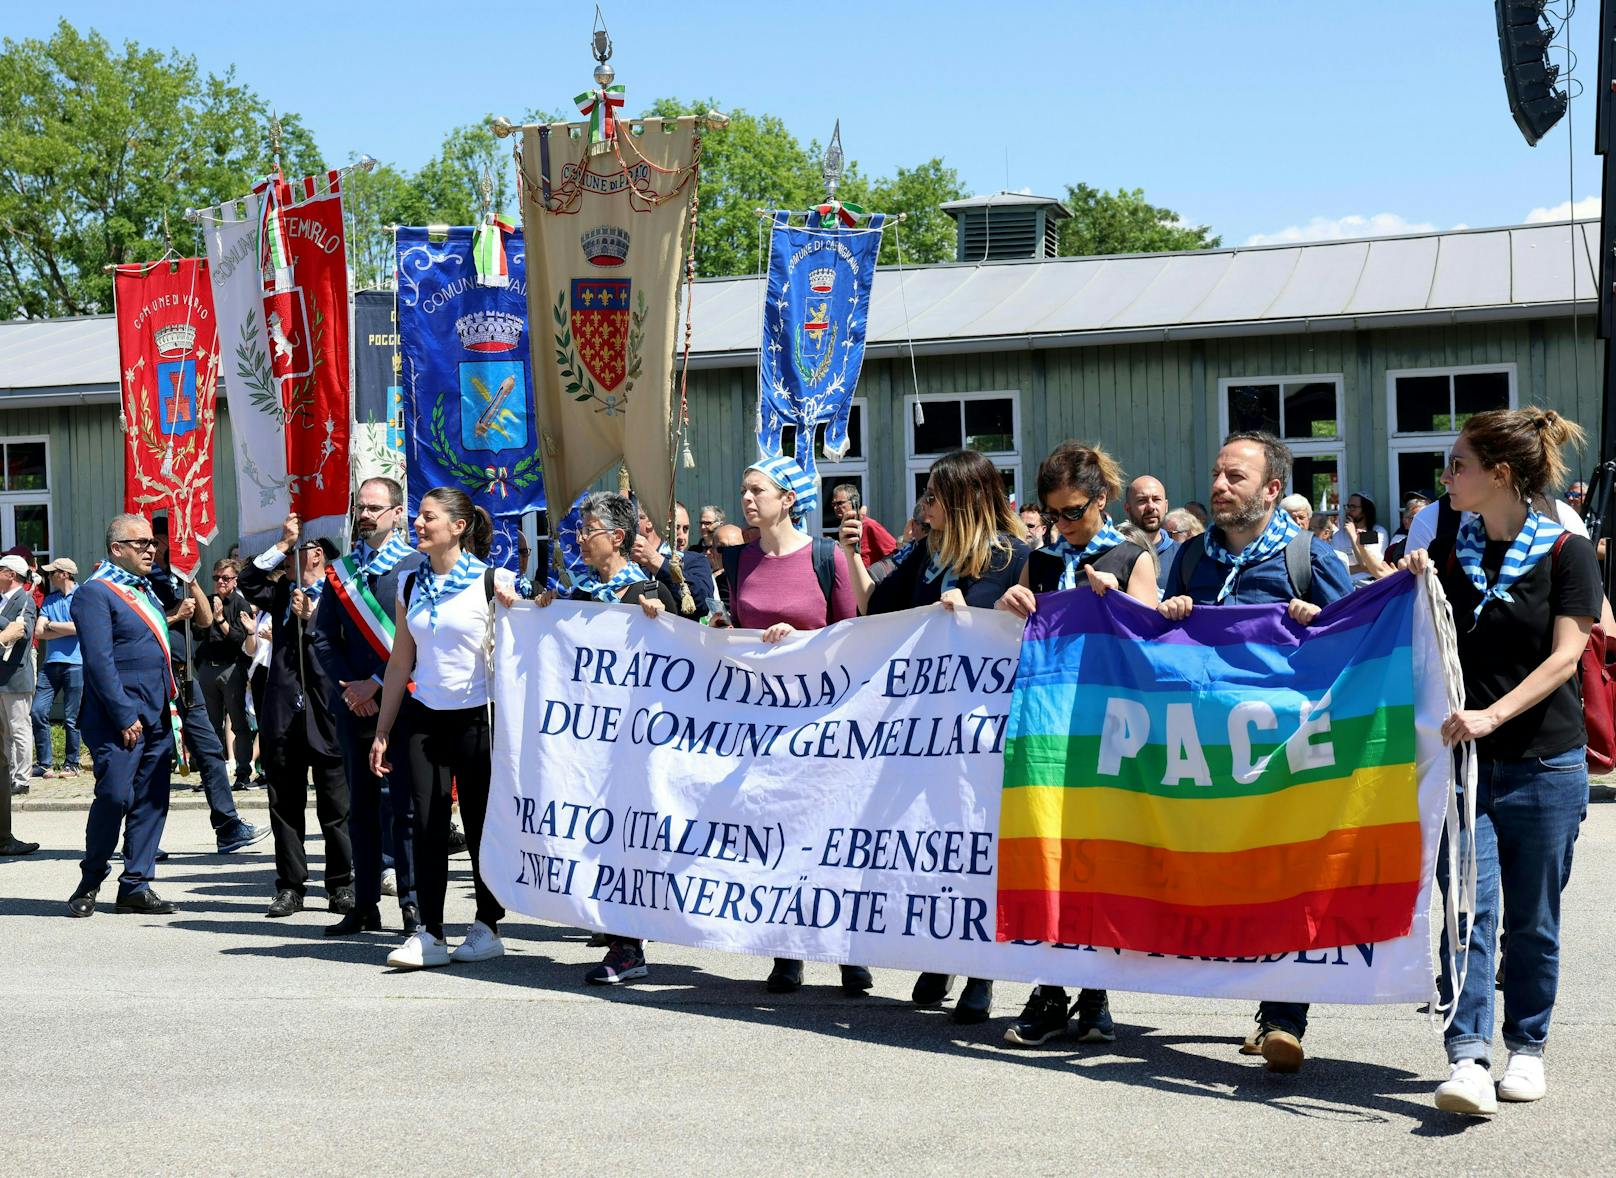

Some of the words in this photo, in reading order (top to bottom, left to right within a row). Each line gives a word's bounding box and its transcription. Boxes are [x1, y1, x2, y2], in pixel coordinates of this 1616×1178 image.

[788, 242, 812, 274] COMUNE
[814, 240, 823, 251] DI
[134, 295, 171, 329] COMUNE
[422, 275, 484, 314] COMUNE
[571, 645, 695, 693] PRATO
[706, 658, 850, 709] (ITALIA)
[540, 699, 624, 743] DUE
[631, 706, 786, 758] COMUNI
[788, 712, 1009, 761] GEMELLATI
[1096, 696, 1337, 786] PACE
[622, 805, 785, 871] (ITALIEN)
[819, 827, 994, 876] EBENSEE
[588, 862, 888, 934] PARTNERSTÄDTE
[901, 886, 993, 943] FÜR
